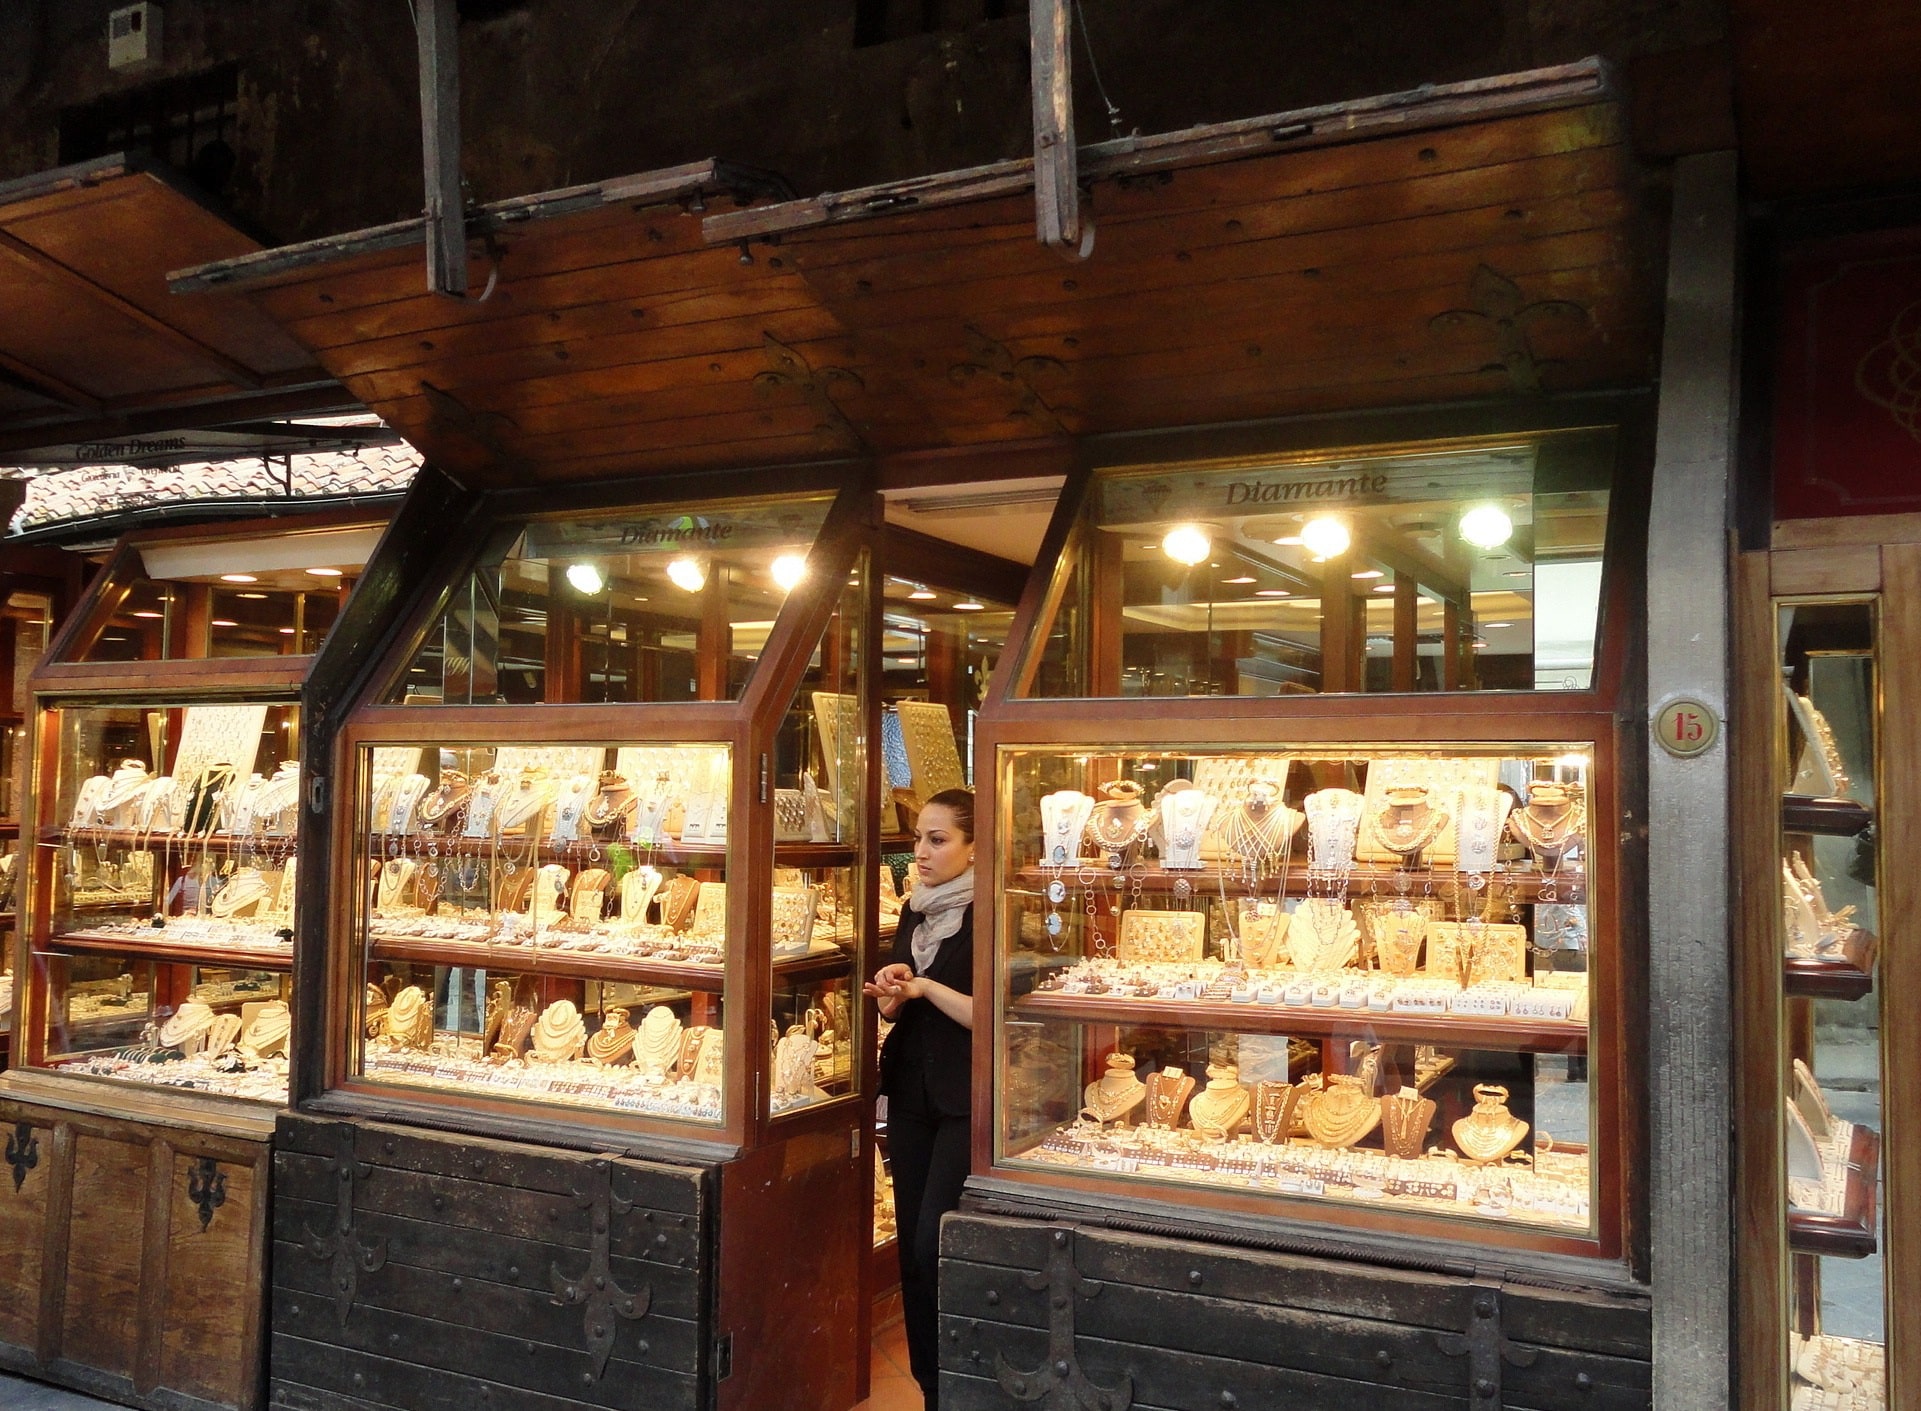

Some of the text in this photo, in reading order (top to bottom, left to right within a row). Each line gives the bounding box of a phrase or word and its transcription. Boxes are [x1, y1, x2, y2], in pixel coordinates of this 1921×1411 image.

[75, 436, 186, 460] Golden Dreams
[1226, 472, 1389, 506] Diamante
[620, 522, 733, 544] Diamante
[1673, 712, 1704, 741] 15
